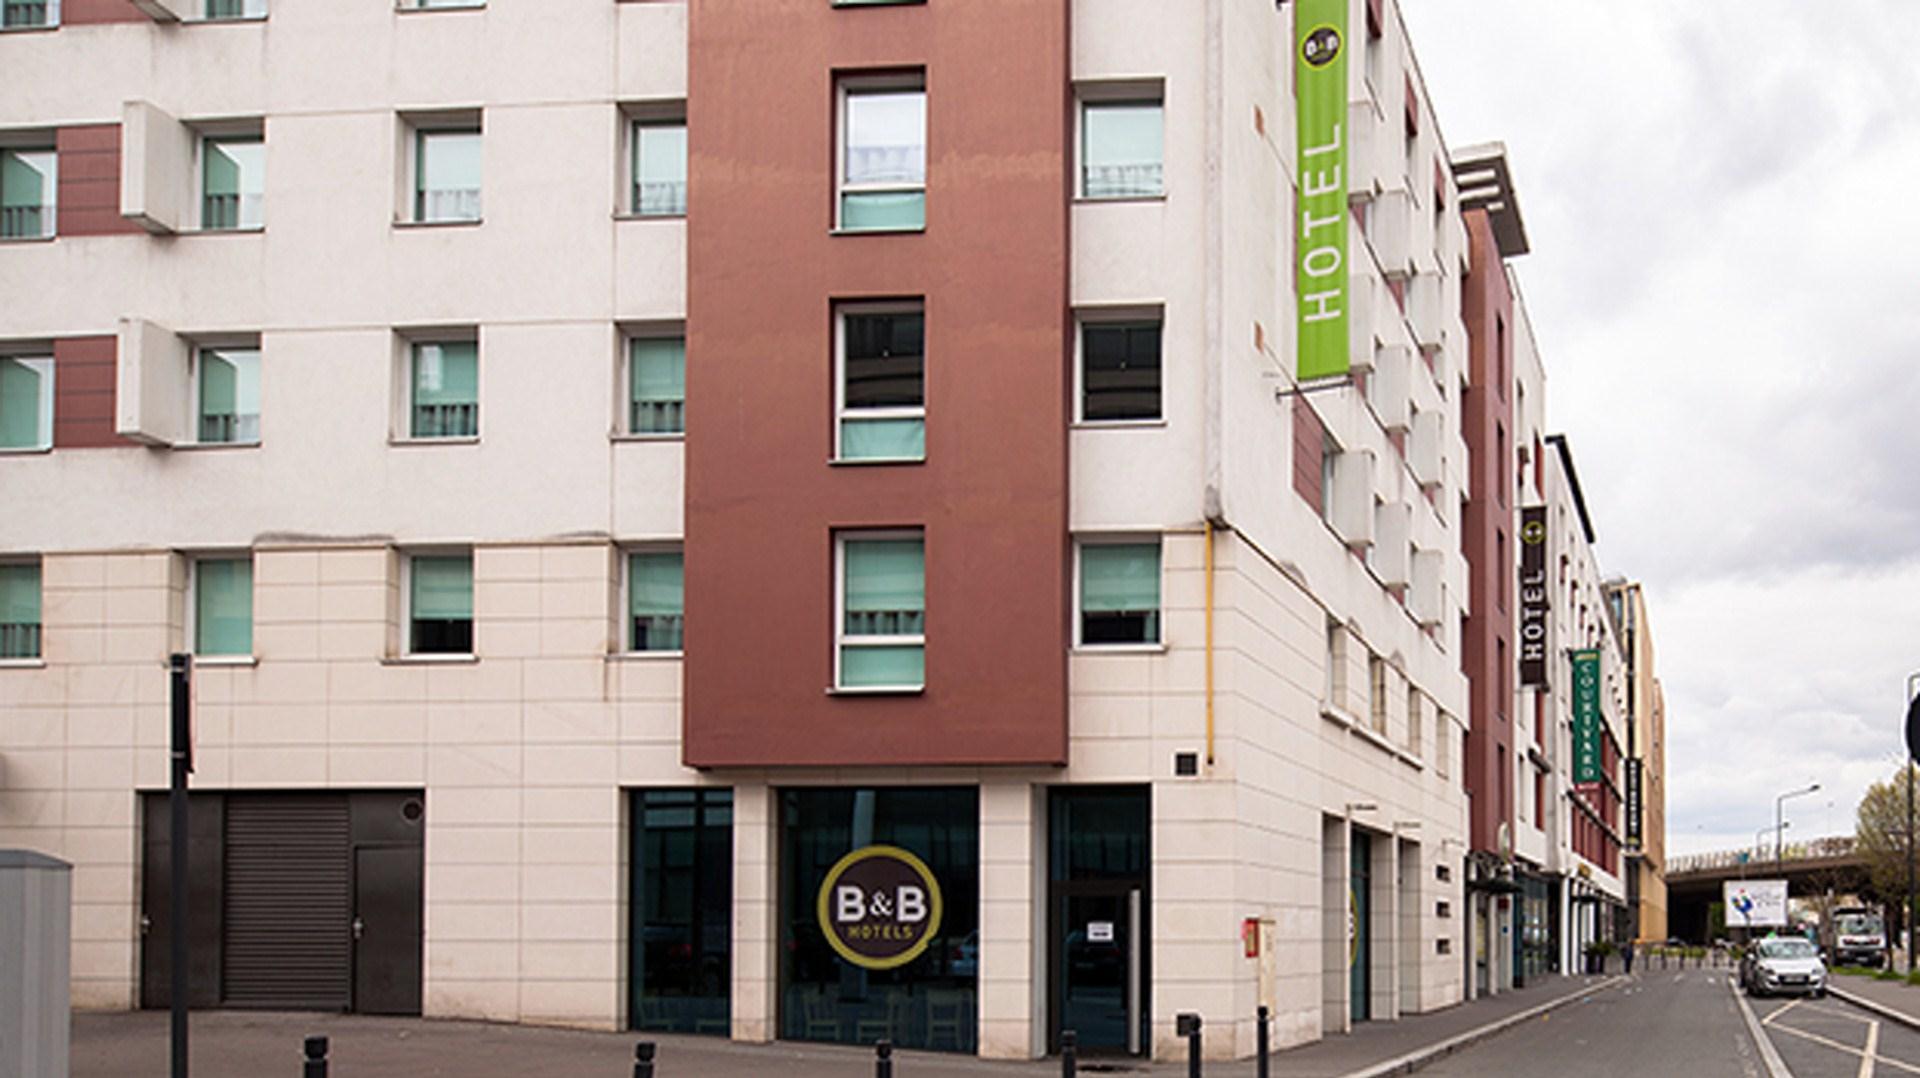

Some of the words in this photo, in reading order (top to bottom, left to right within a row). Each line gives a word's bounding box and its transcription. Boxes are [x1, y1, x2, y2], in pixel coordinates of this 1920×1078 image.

[1303, 122, 1341, 323] HOTEL
[1523, 569, 1544, 661] HOTEL
[837, 885, 928, 923] B&B
[847, 925, 914, 940] HOTELS
